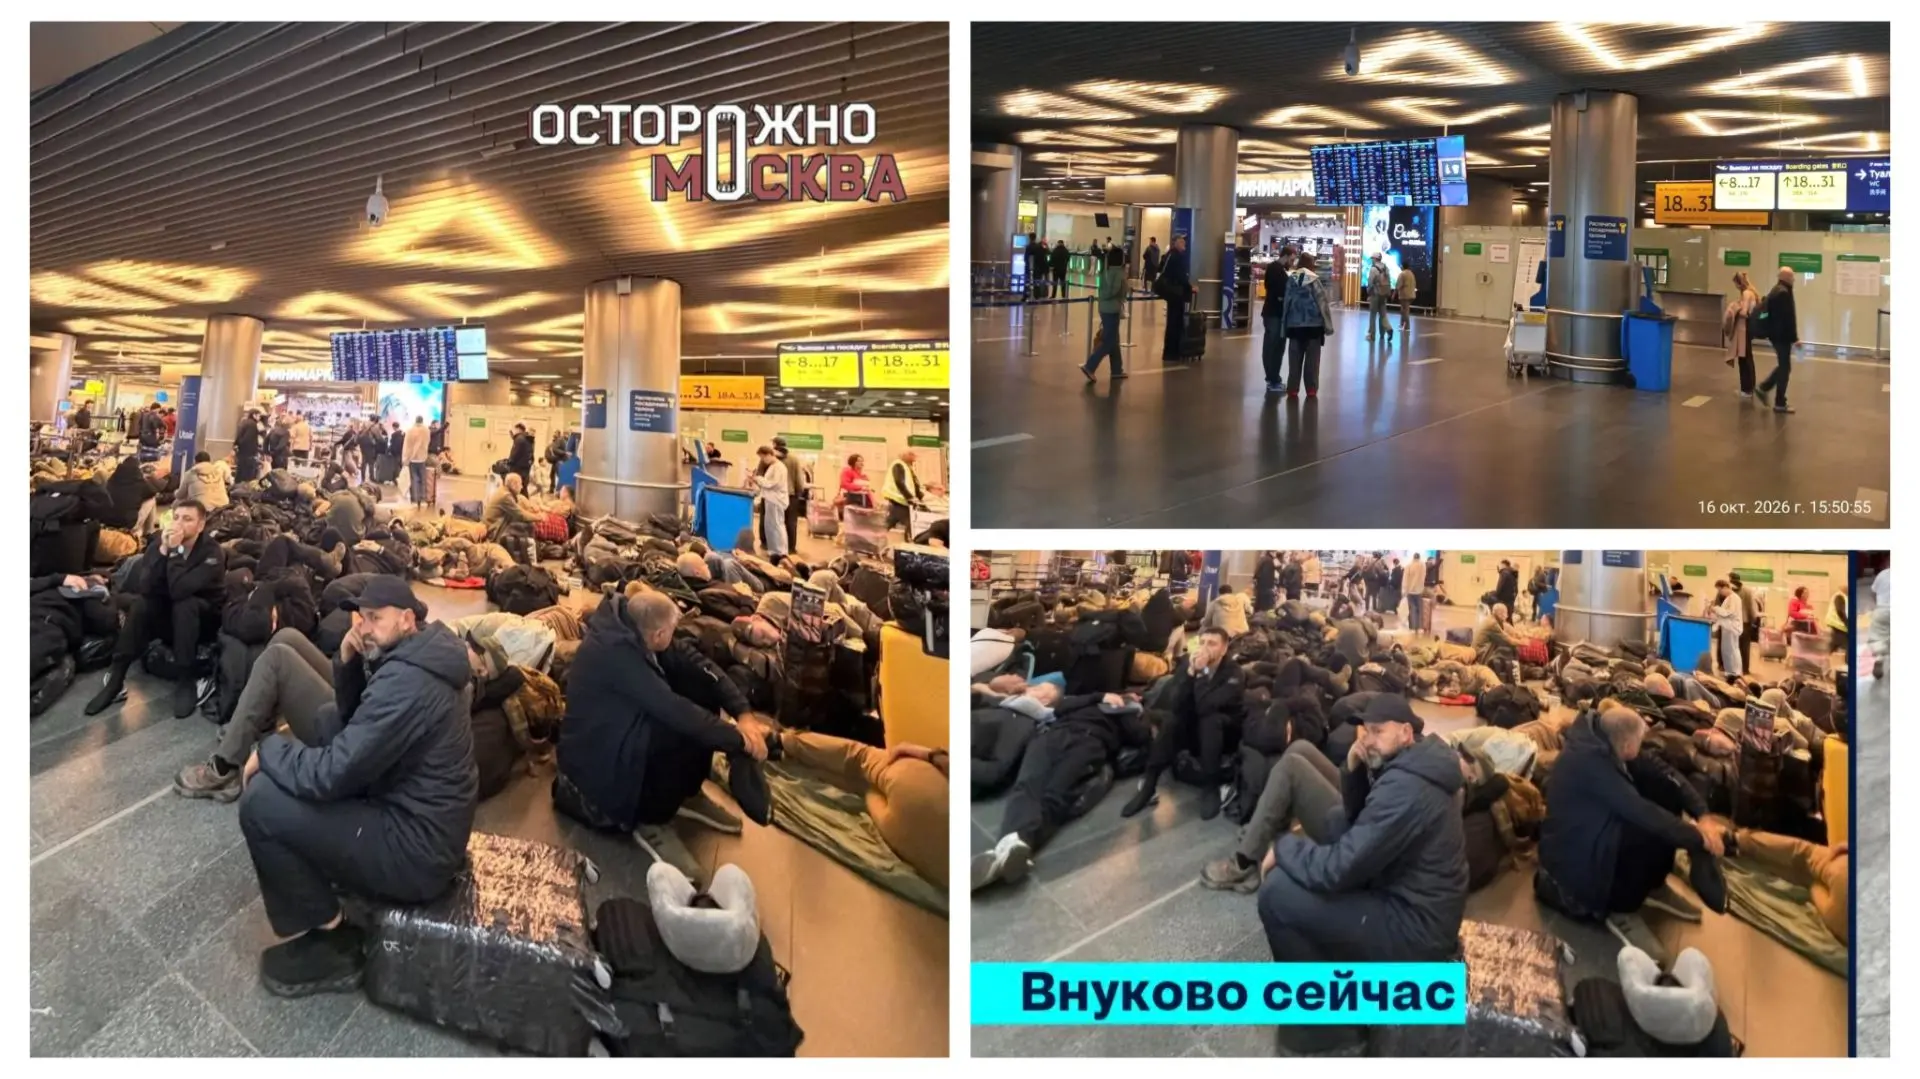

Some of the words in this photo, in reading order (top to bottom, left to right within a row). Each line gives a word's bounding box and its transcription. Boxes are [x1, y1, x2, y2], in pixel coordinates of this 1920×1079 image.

[1236, 179, 1315, 197] МИНИМАРК
[265, 368, 333, 381] МИНИМАРК
[680, 385, 711, 399] ...31
